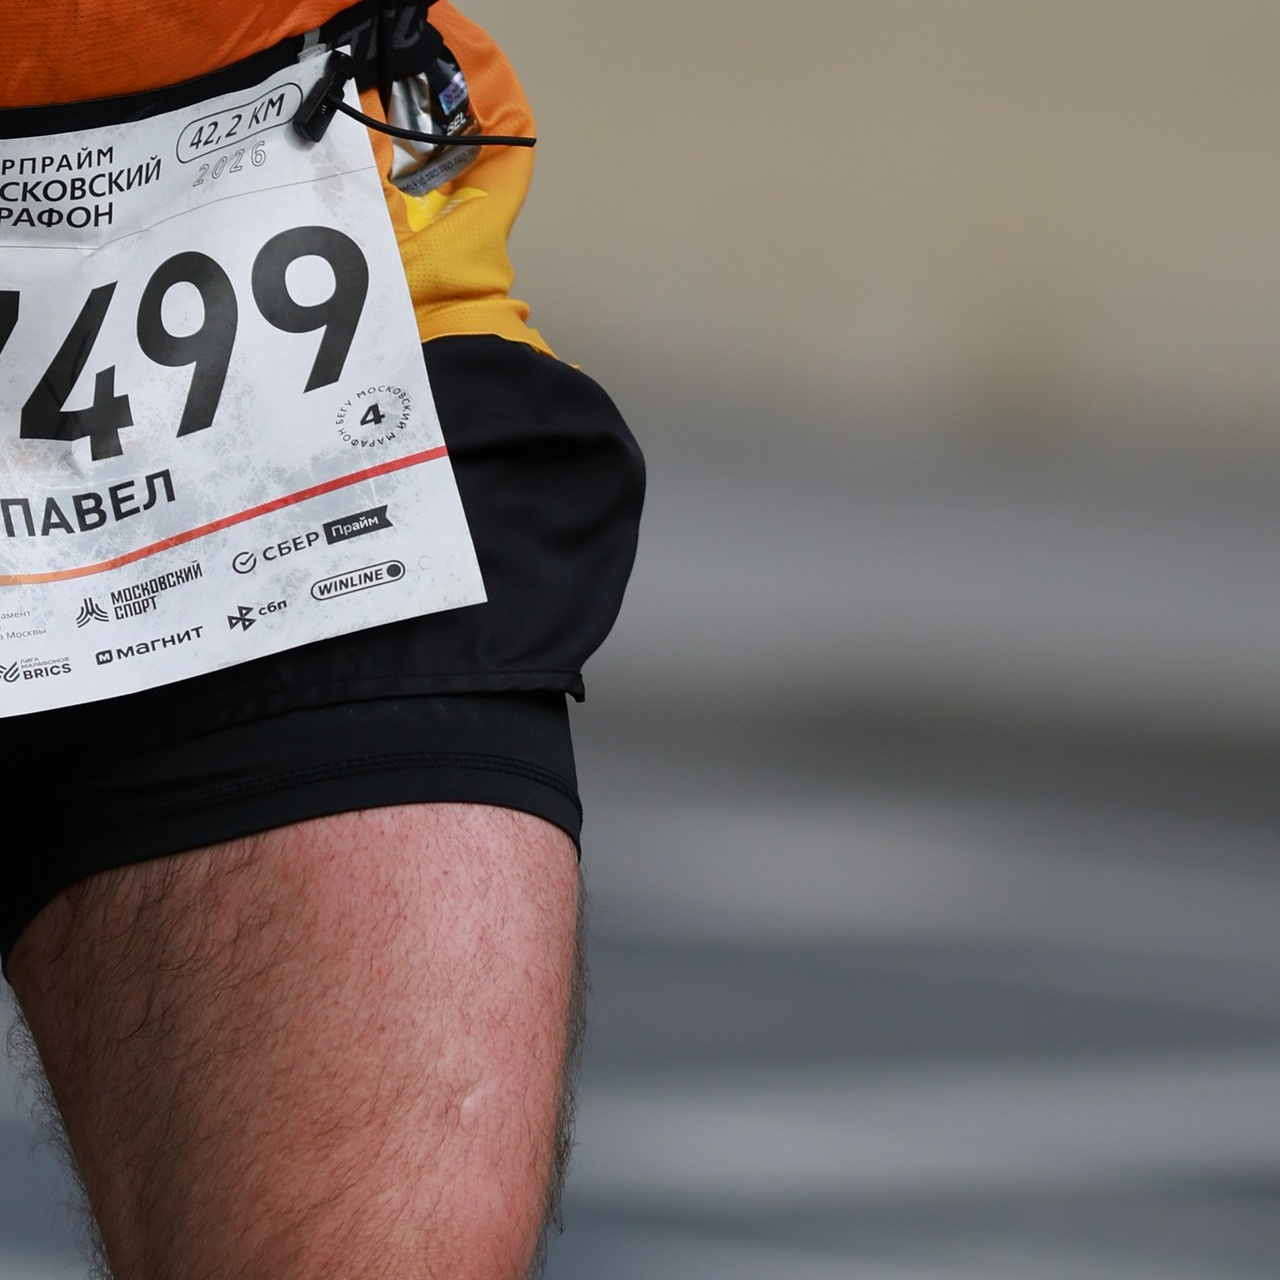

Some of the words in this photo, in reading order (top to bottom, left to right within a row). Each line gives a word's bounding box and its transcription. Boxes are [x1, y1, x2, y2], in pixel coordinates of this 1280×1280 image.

[189, 114, 242, 150] 42,2
[193, 142, 267, 187] 2026
[336, 400, 352, 425] БЕГУ
[356, 385, 411, 430] МОСКОВСКИЙ
[360, 403, 386, 426] 4
[337, 427, 396, 448] МАРАФОН
[0, 469, 177, 538] ПАВЕЛ
[262, 531, 320, 561] СБЕР
[331, 515, 379, 537] Прайм
[110, 560, 203, 606] МОСКОВСКИЙ
[318, 568, 384, 596] WINLINE
[113, 595, 158, 621] СПОРТ
[258, 599, 288, 616] сбп
[6, 628, 47, 640] Москвы
[22, 663, 72, 680] BRICS
